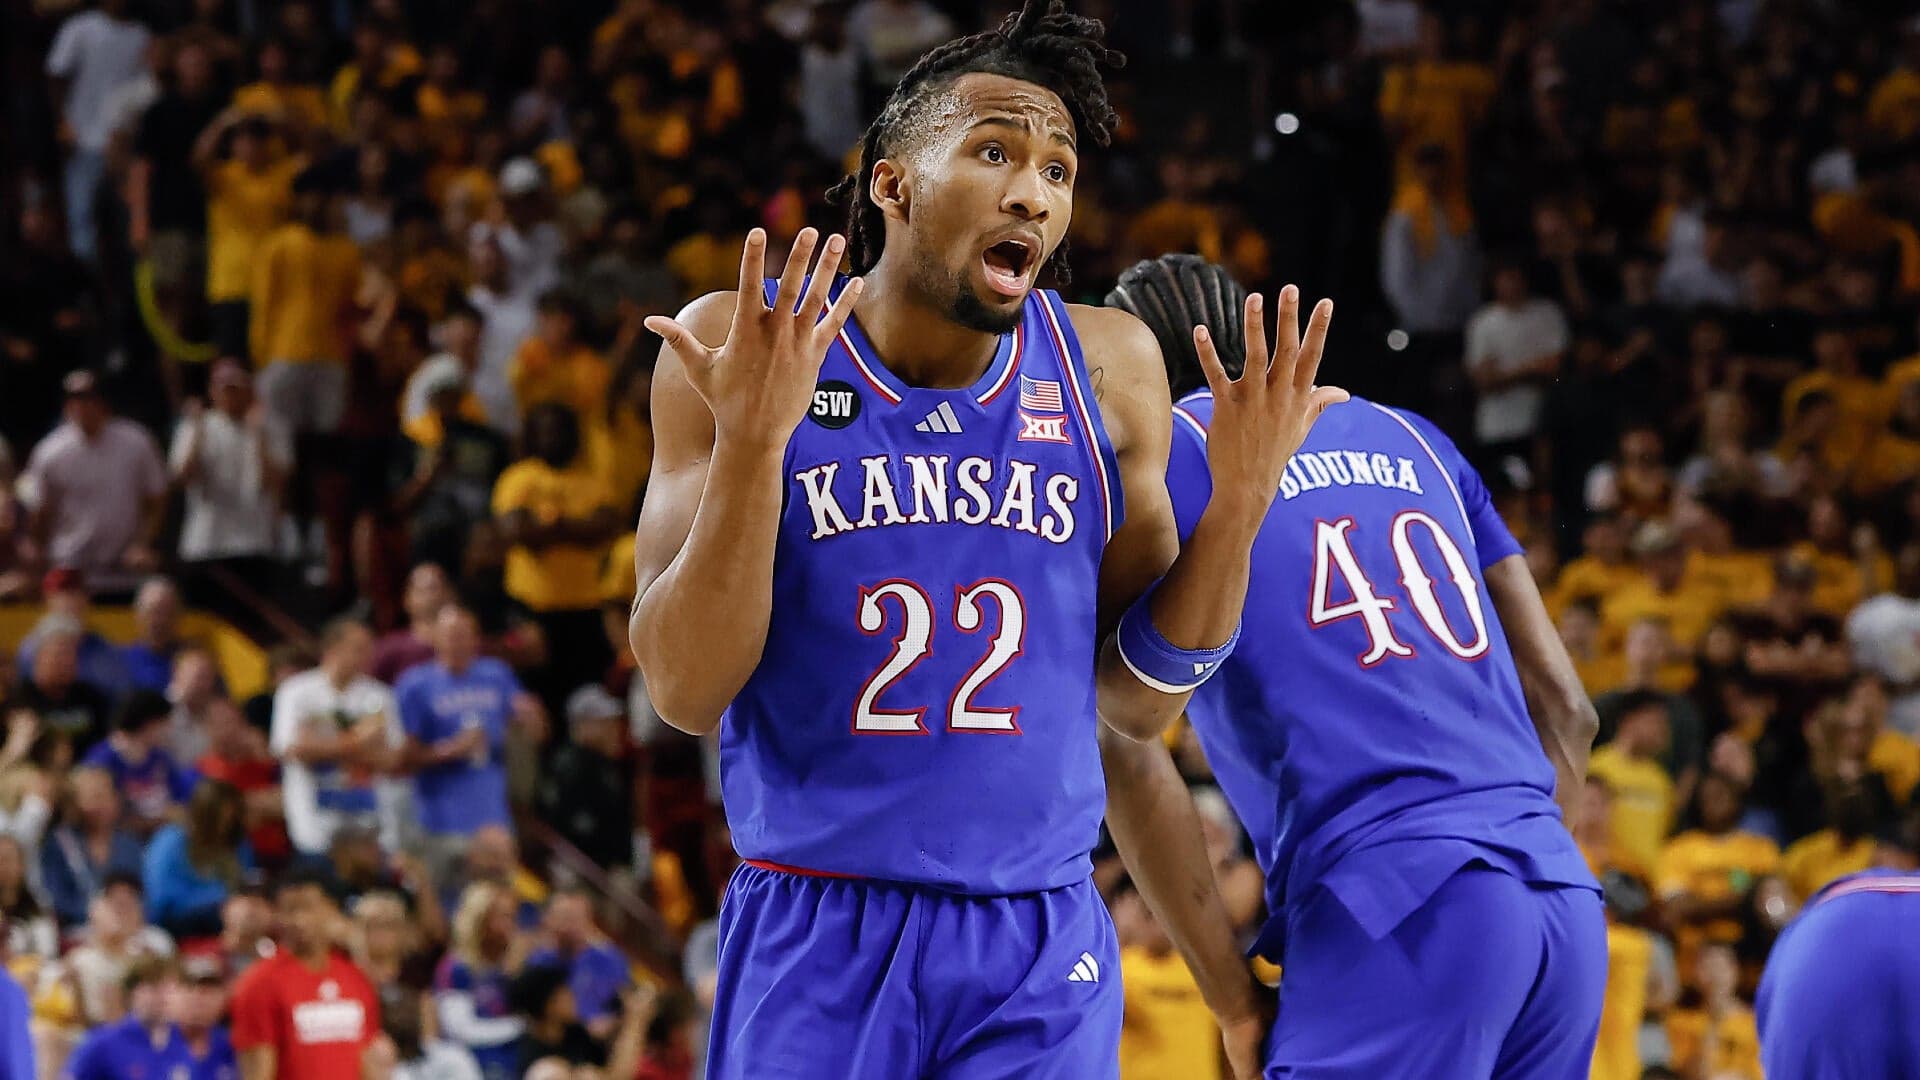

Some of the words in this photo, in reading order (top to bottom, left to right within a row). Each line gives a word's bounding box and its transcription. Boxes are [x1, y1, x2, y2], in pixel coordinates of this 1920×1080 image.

[813, 390, 853, 417] SW
[1018, 411, 1071, 443] XII
[795, 455, 1079, 543] KANSAS
[1309, 510, 1490, 667] 40
[851, 577, 1027, 735] 22
